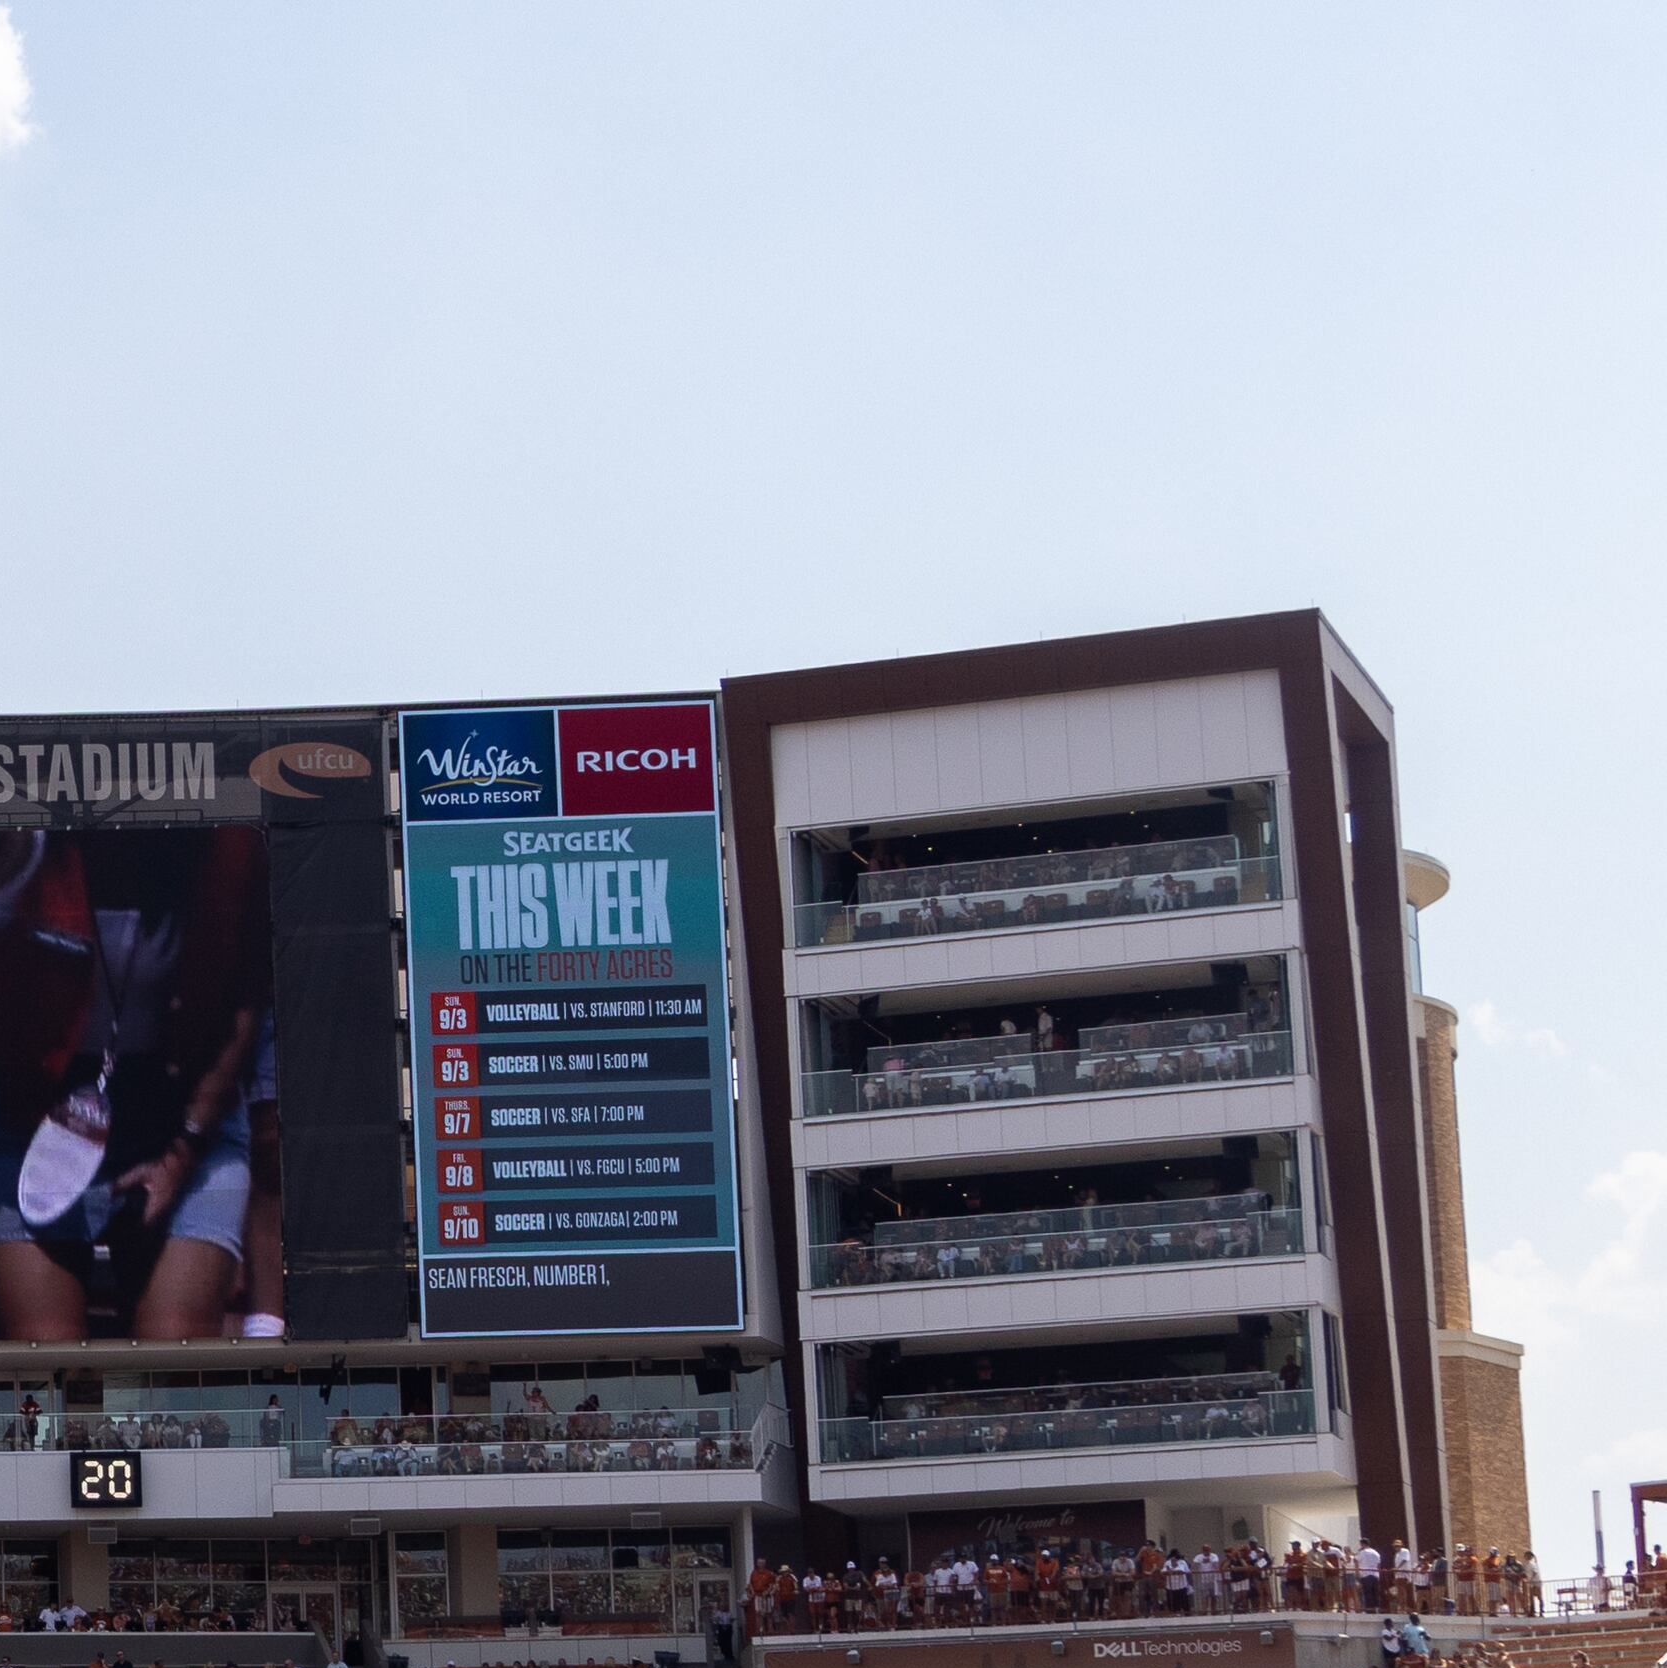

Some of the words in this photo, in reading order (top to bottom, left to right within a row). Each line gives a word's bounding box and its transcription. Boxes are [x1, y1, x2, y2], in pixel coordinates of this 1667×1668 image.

[297, 748, 353, 769] ufcu
[417, 735, 542, 786] WinStar
[576, 748, 697, 773] RICOH
[421, 792, 479, 805] WORLD
[483, 790, 542, 804] RESORT
[503, 827, 634, 857] SEATGEEK
[450, 864, 550, 951] THIS
[552, 859, 672, 947] WEEK
[460, 954, 489, 984] ON
[493, 952, 532, 983] THE
[537, 950, 600, 982] FORTY
[606, 949, 673, 979] ACRES
[439, 1011, 467, 1030] 9/3
[486, 1003, 560, 1022] VOLLEYBALL
[570, 1002, 588, 1018] VS.
[590, 1000, 645, 1018] STANFORD
[655, 999, 682, 1015] 11:30
[684, 999, 702, 1015] AM
[441, 1061, 469, 1082] 9/3
[488, 1055, 539, 1074] SOCCER
[549, 1054, 567, 1071] VS.
[568, 1053, 593, 1070] SMU
[603, 1053, 628, 1069] 5:00
[630, 1052, 648, 1068] PM
[444, 1113, 471, 1134] 9/7
[491, 1108, 541, 1126] SOCCER
[551, 1107, 569, 1123] VS.
[570, 1106, 591, 1123] SFA
[601, 1106, 625, 1122] 7:00
[626, 1106, 644, 1121] PM
[445, 1165, 474, 1187] 9/8
[493, 1160, 567, 1179] VOLLEYBALL
[577, 1159, 595, 1175] VS.
[596, 1159, 624, 1175] FGCU
[635, 1158, 661, 1174] 5:00
[662, 1158, 680, 1173] PM
[444, 1218, 479, 1240] 9/10
[495, 1213, 545, 1232] SOCCER
[555, 1212, 574, 1229] VS.
[633, 1211, 658, 1227] 2:00
[660, 1210, 678, 1226] PM
[429, 1268, 466, 1289] SEAN
[470, 1265, 531, 1288] FRESCH,
[533, 1265, 597, 1287] NUMBER
[81, 1460, 131, 1498] 20
[1094, 1642, 1141, 1657] DELL
[1141, 1639, 1241, 1656] Technologies
